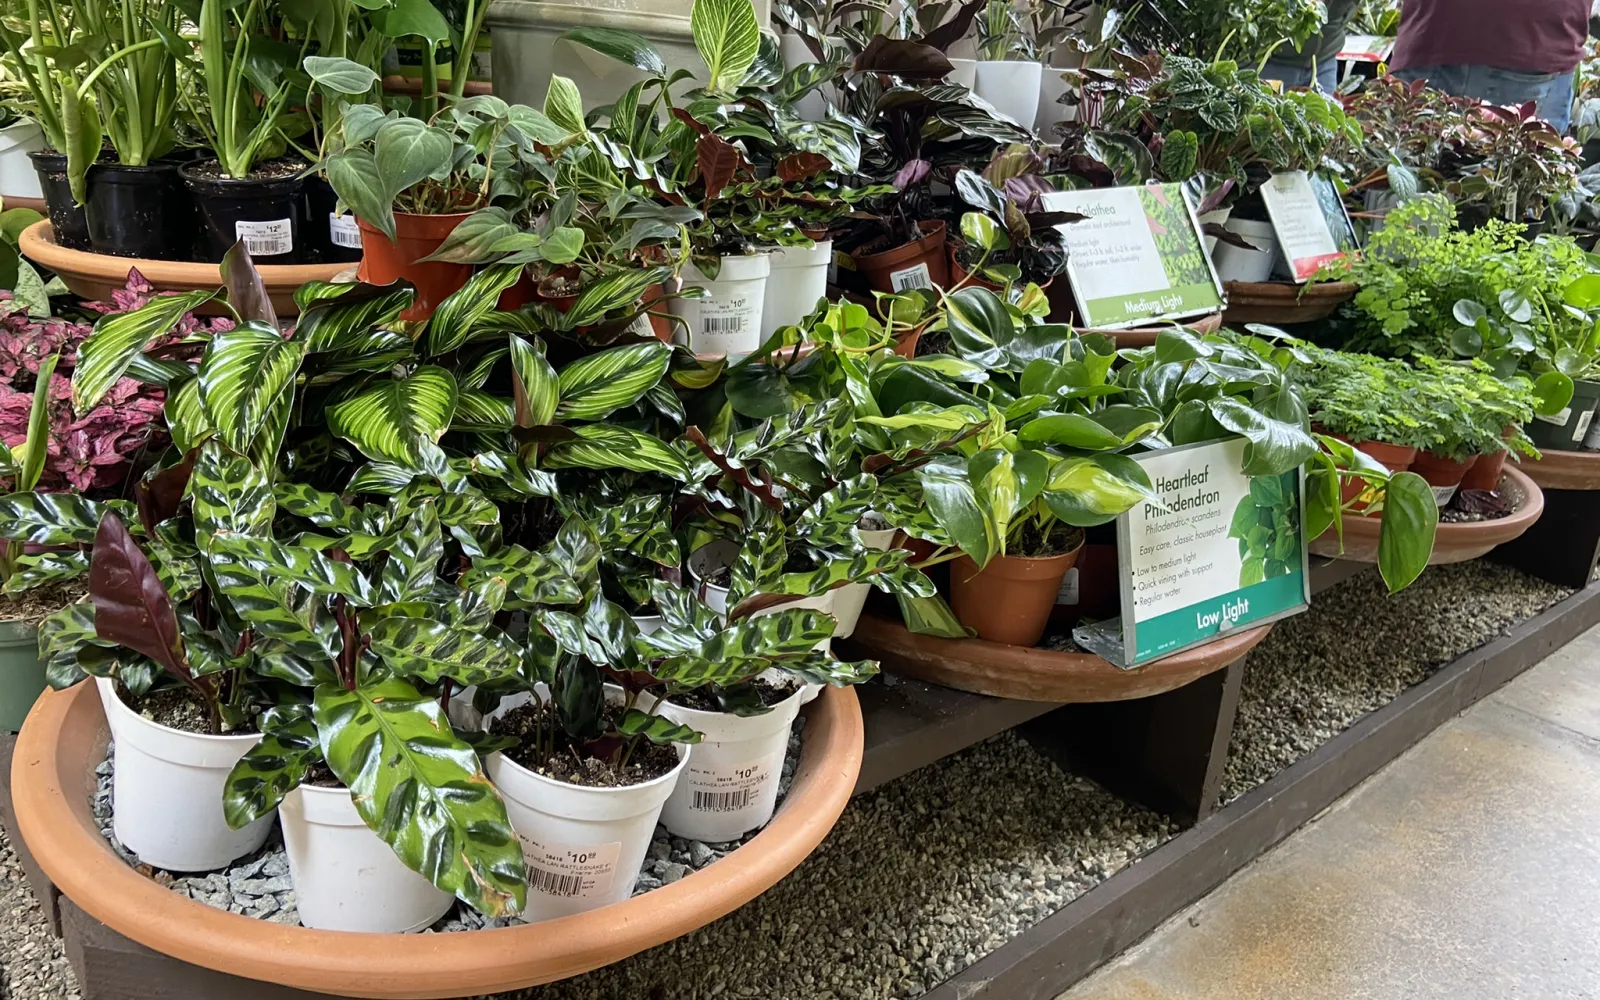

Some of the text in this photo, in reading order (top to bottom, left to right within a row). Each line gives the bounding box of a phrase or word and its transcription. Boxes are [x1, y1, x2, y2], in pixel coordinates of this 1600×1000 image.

[1124, 293, 1183, 313] Medium Light
[1156, 464, 1209, 494] Heartleaf
[1144, 489, 1220, 520] Philodendron
[1191, 508, 1221, 523] scandens
[1140, 524, 1227, 556] Easy care, classic houseplant
[1137, 551, 1197, 577] Low to medium light
[1138, 562, 1213, 591] Quick vining with support
[1139, 587, 1181, 606] Regular water
[1196, 597, 1249, 629] Low Light
[688, 779, 717, 788] CALATHEA
[523, 851, 546, 864] LATHEA
[546, 859, 559, 868] LAN
[545, 854, 563, 862] 58418
